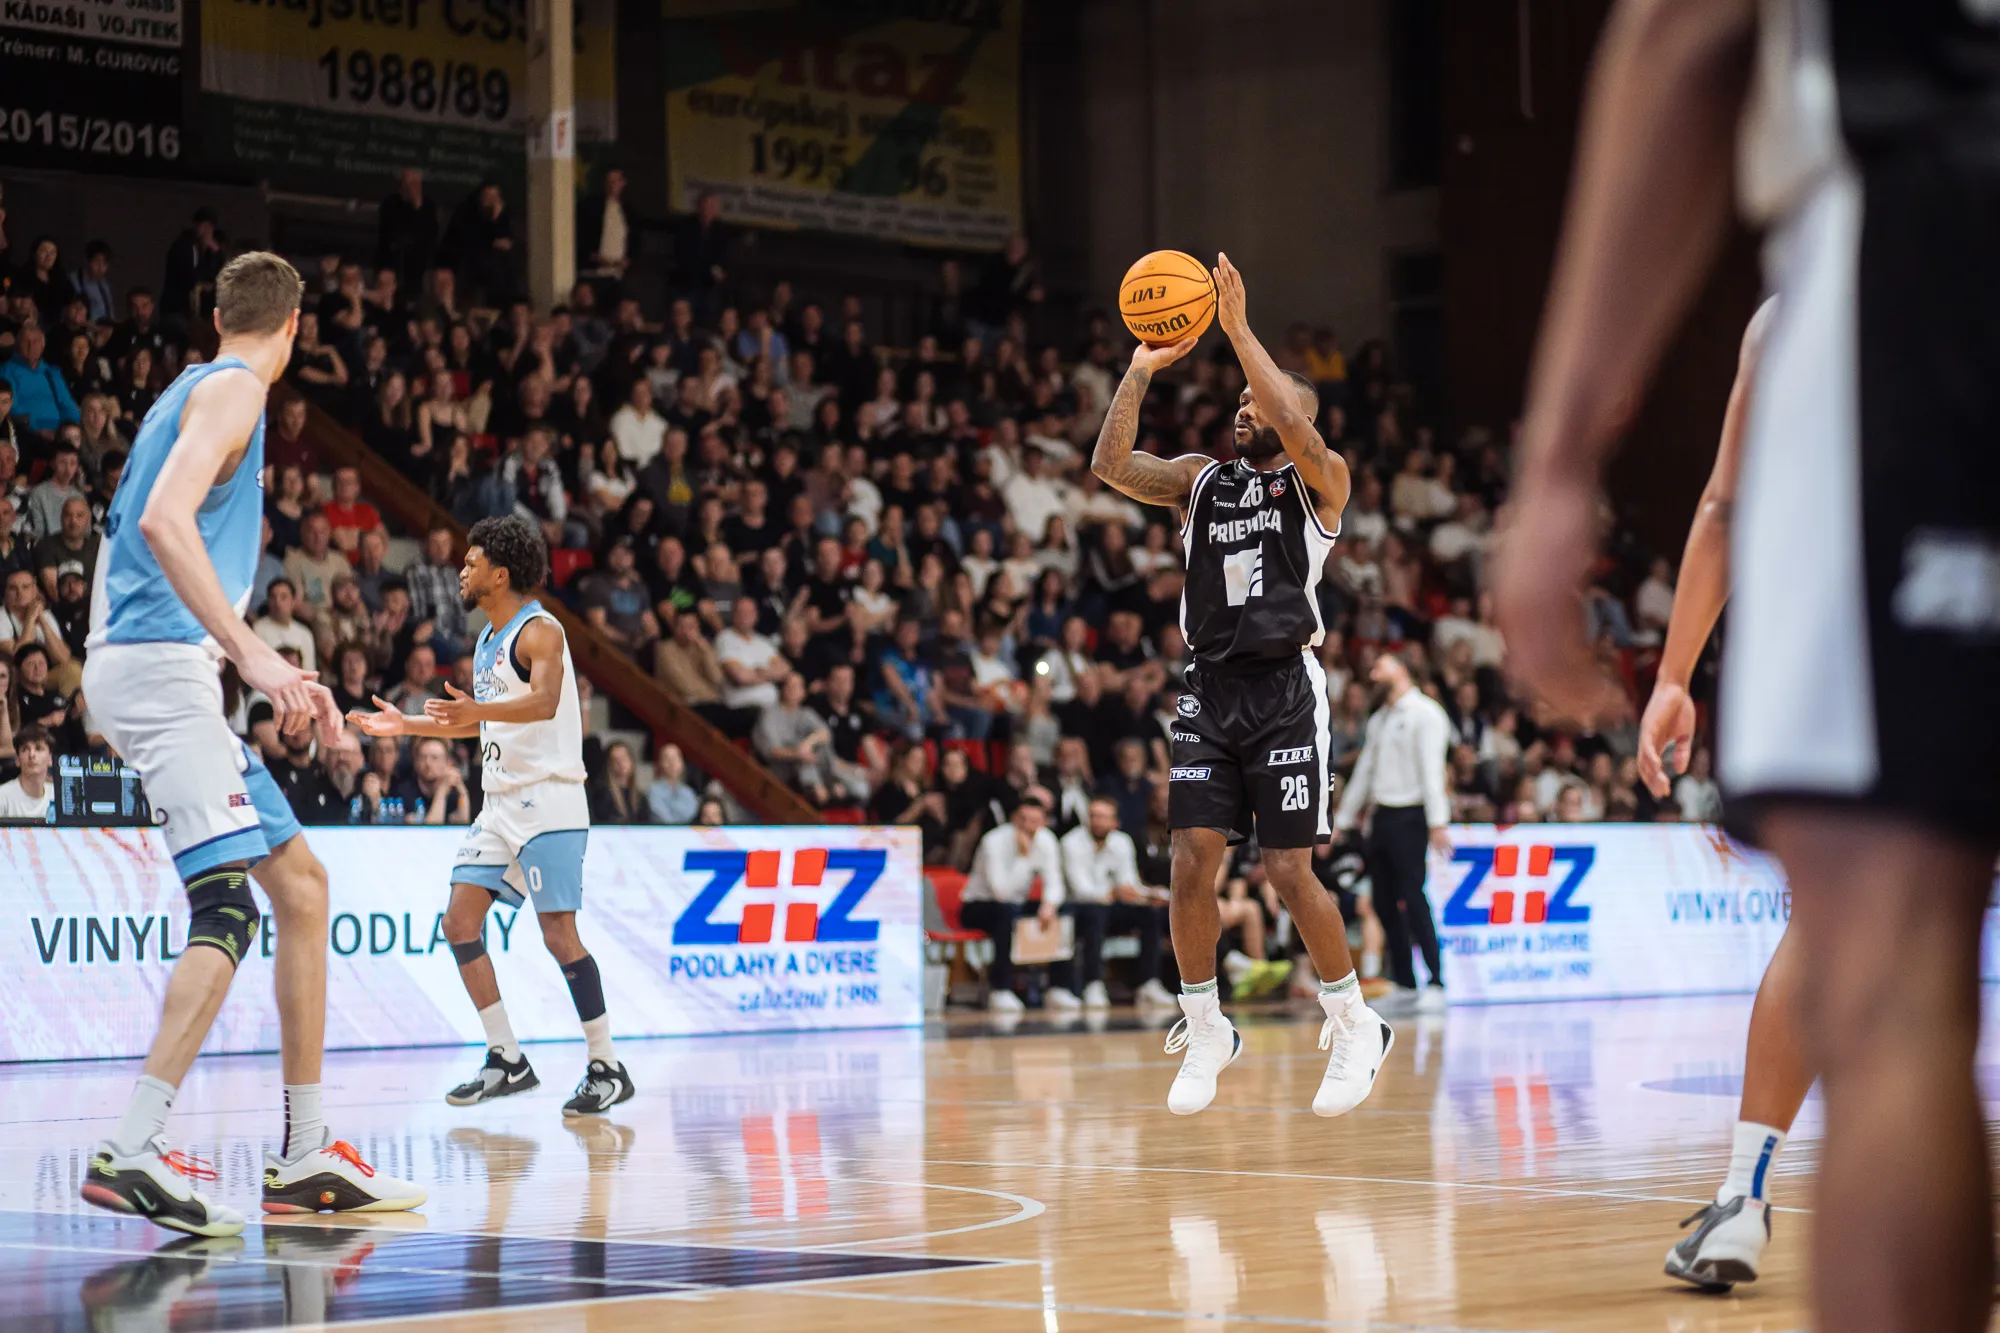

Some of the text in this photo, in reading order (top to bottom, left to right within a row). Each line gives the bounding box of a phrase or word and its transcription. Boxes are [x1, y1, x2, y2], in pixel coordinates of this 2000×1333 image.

[97, 14, 179, 41] VOJTEK
[320, 46, 510, 121] 1988/89
[0, 106, 181, 161] 2015/2016
[1128, 312, 1191, 337] Wilson
[1171, 769, 1207, 779] TIPOS
[1280, 774, 1310, 811] 26
[528, 866, 543, 893] 0
[784, 951, 800, 976] A
[805, 948, 879, 975] DVERE
